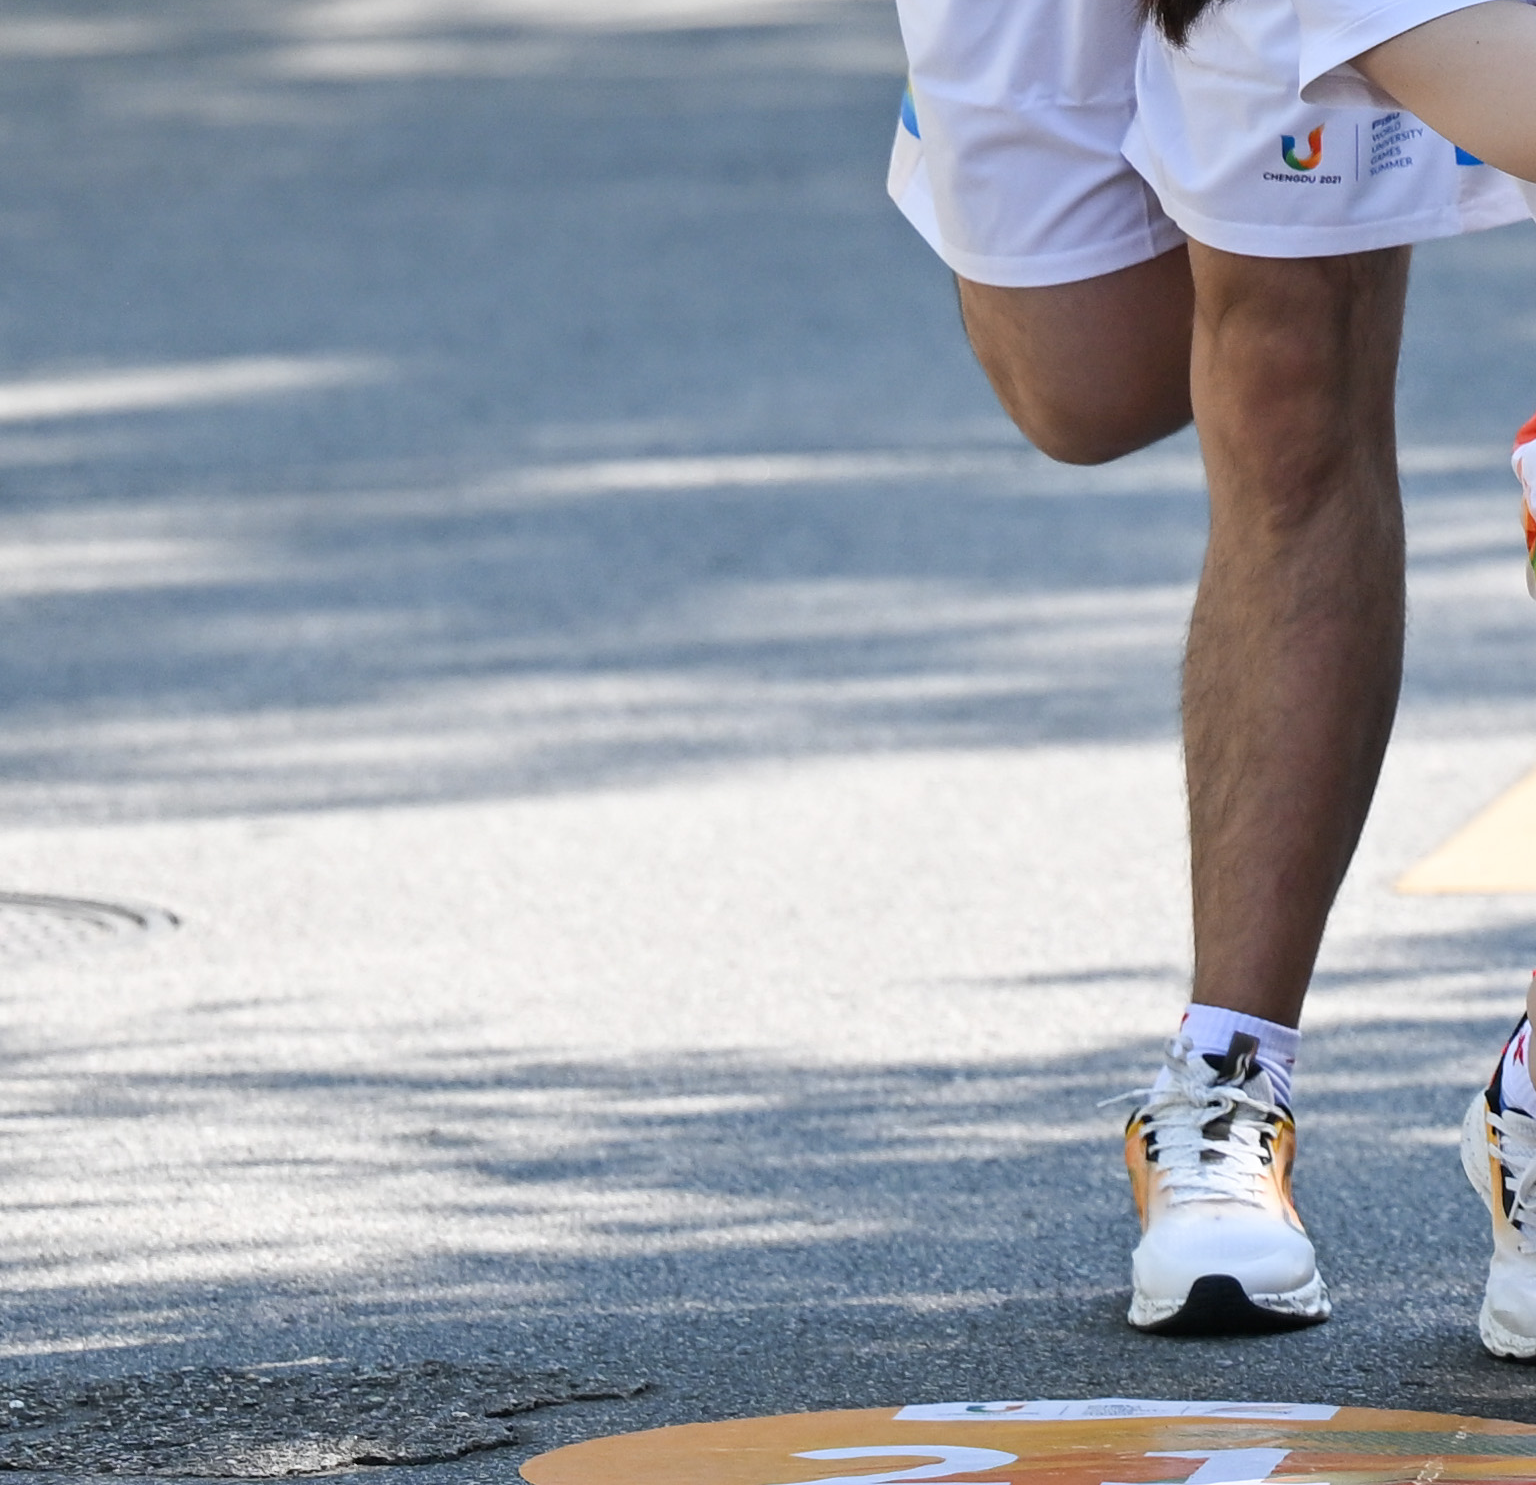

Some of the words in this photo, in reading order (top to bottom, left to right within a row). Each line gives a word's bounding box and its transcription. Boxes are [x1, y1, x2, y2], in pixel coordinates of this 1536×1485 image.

[1371, 128, 1424, 154] UNIVERSITY
[1372, 121, 1401, 142] WORLD
[1370, 146, 1402, 165] GAMES
[1369, 156, 1413, 176] SUMMER
[1263, 172, 1316, 183] CHENGDU
[1319, 175, 1341, 184] 2021
